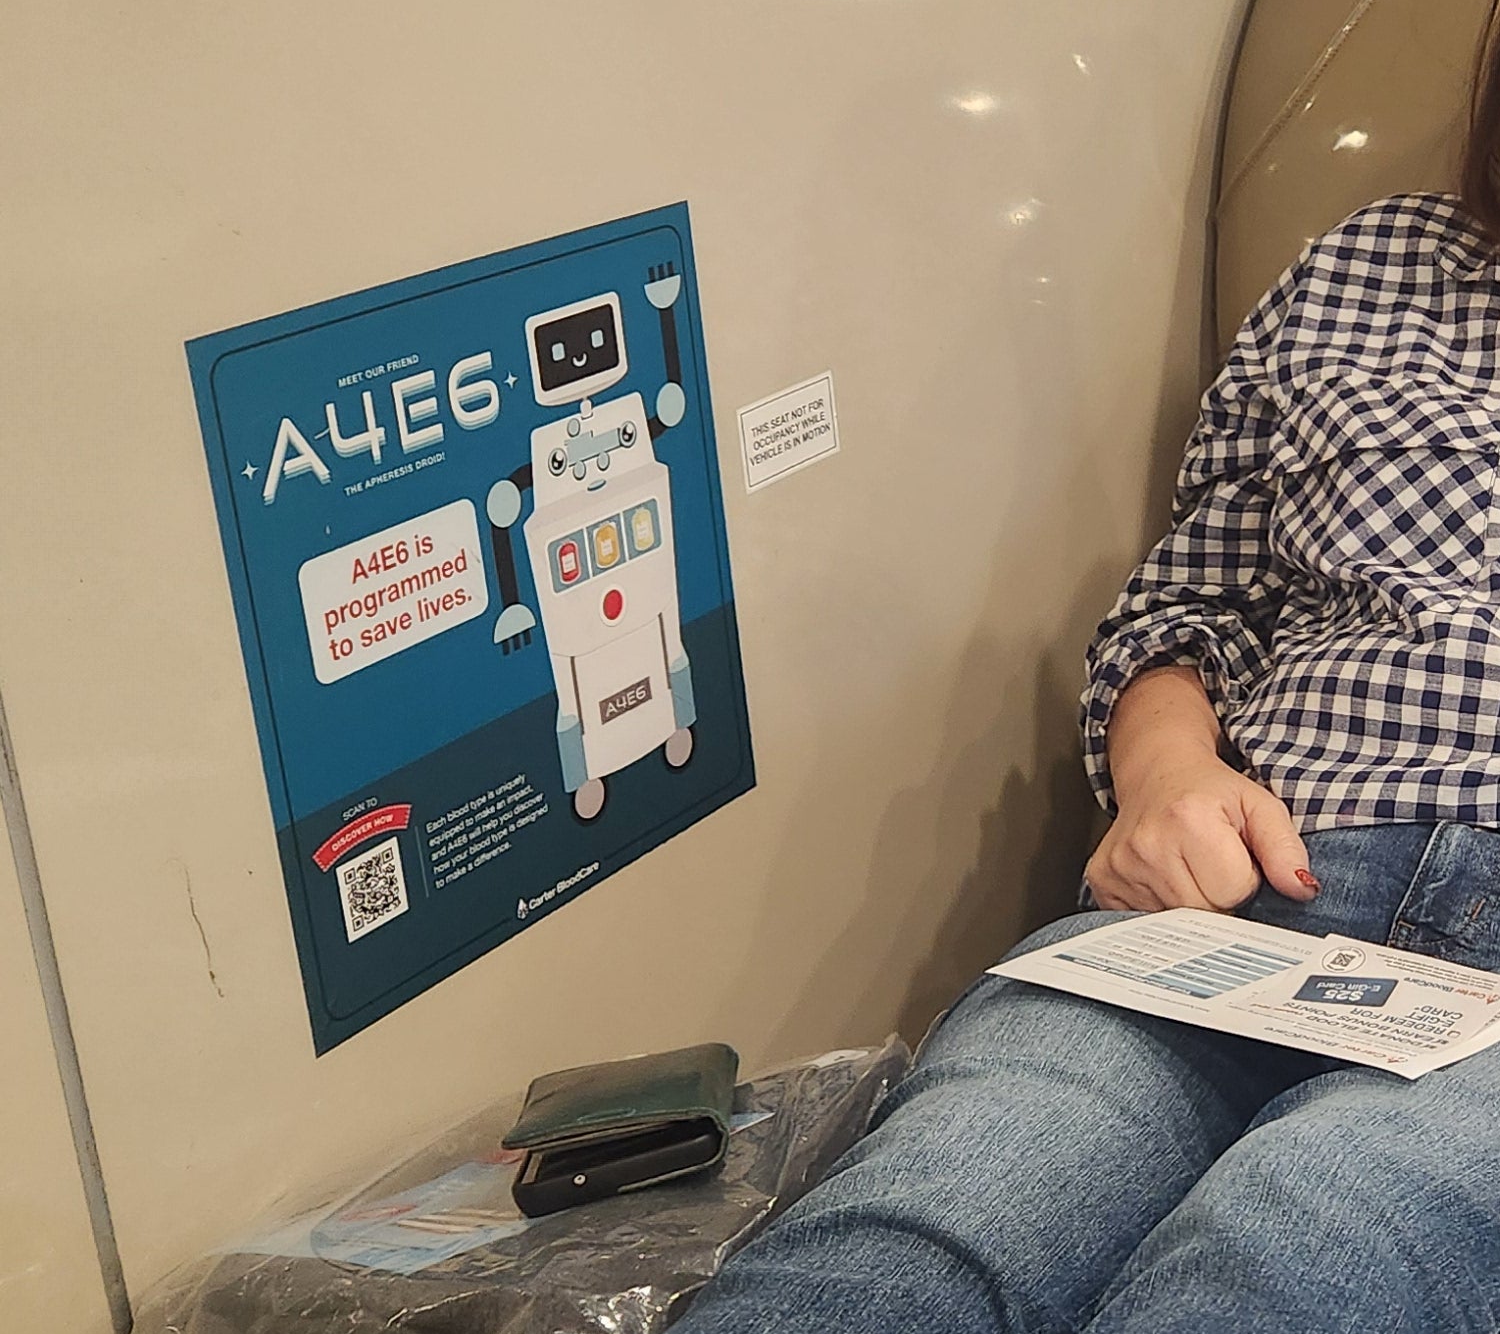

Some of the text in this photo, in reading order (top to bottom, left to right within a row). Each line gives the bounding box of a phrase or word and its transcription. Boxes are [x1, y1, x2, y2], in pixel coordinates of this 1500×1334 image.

[338, 354, 420, 388] MEET OUR FRIEND
[263, 351, 500, 505] A4E6
[751, 398, 824, 437] THIS SEAT NOT FOR
[753, 411, 826, 451] OCCUPANCY WHILE
[749, 422, 831, 466] VEHICLE IS IN MOTION
[344, 451, 446, 496] THE APHERESIS DROID!
[352, 534, 433, 584] A4E6 is
[324, 548, 468, 635] programmed
[329, 588, 472, 660] to save lives.
[606, 685, 646, 717] A4E6
[342, 797, 378, 821] SCAN TO
[426, 774, 526, 833] Each blood type is uniquely
[331, 814, 394, 851] DISCOVER HOW
[429, 821, 465, 846] equipped
[465, 818, 474, 827] to
[474, 805, 496, 822] make
[496, 799, 506, 810] an
[431, 792, 544, 861] and A4E6 will help you discover
[433, 803, 549, 874] how your blood type is designed
[435, 879, 445, 889] to
[445, 866, 467, 883] make
[467, 863, 473, 871] a
[529, 861, 599, 910] Carter BloodCare
[1316, 981, 1381, 992] E-Gift Card
[1321, 988, 1364, 1002] $25
[1403, 977, 1487, 1000] Carter BloodCare
[1282, 1002, 1337, 1018] POINTS
[1306, 1015, 1359, 1031] BLOOD
[1336, 1015, 1390, 1031] BONUS
[1349, 1007, 1448, 1035] REDEEM FOR
[1403, 1011, 1456, 1028] E-GIFT
[1359, 1026, 1422, 1049] DONATE
